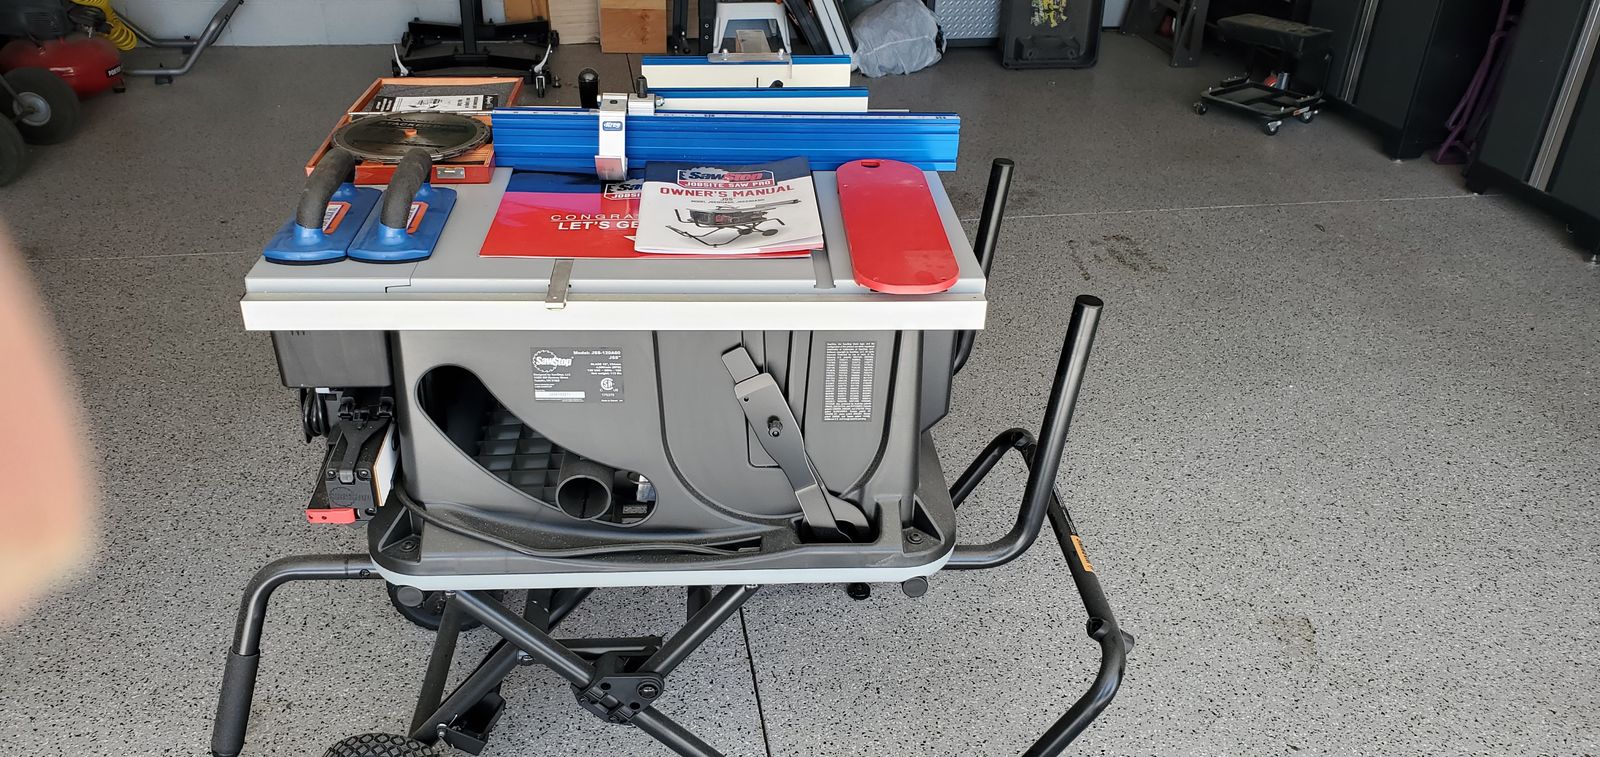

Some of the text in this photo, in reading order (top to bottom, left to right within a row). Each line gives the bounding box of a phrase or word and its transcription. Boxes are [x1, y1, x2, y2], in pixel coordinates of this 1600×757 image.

[688, 171, 764, 181] SawStop
[660, 184, 795, 198] OWNER'S MANUAL
[558, 221, 610, 230] LET'S
[536, 356, 572, 366] SawStop
